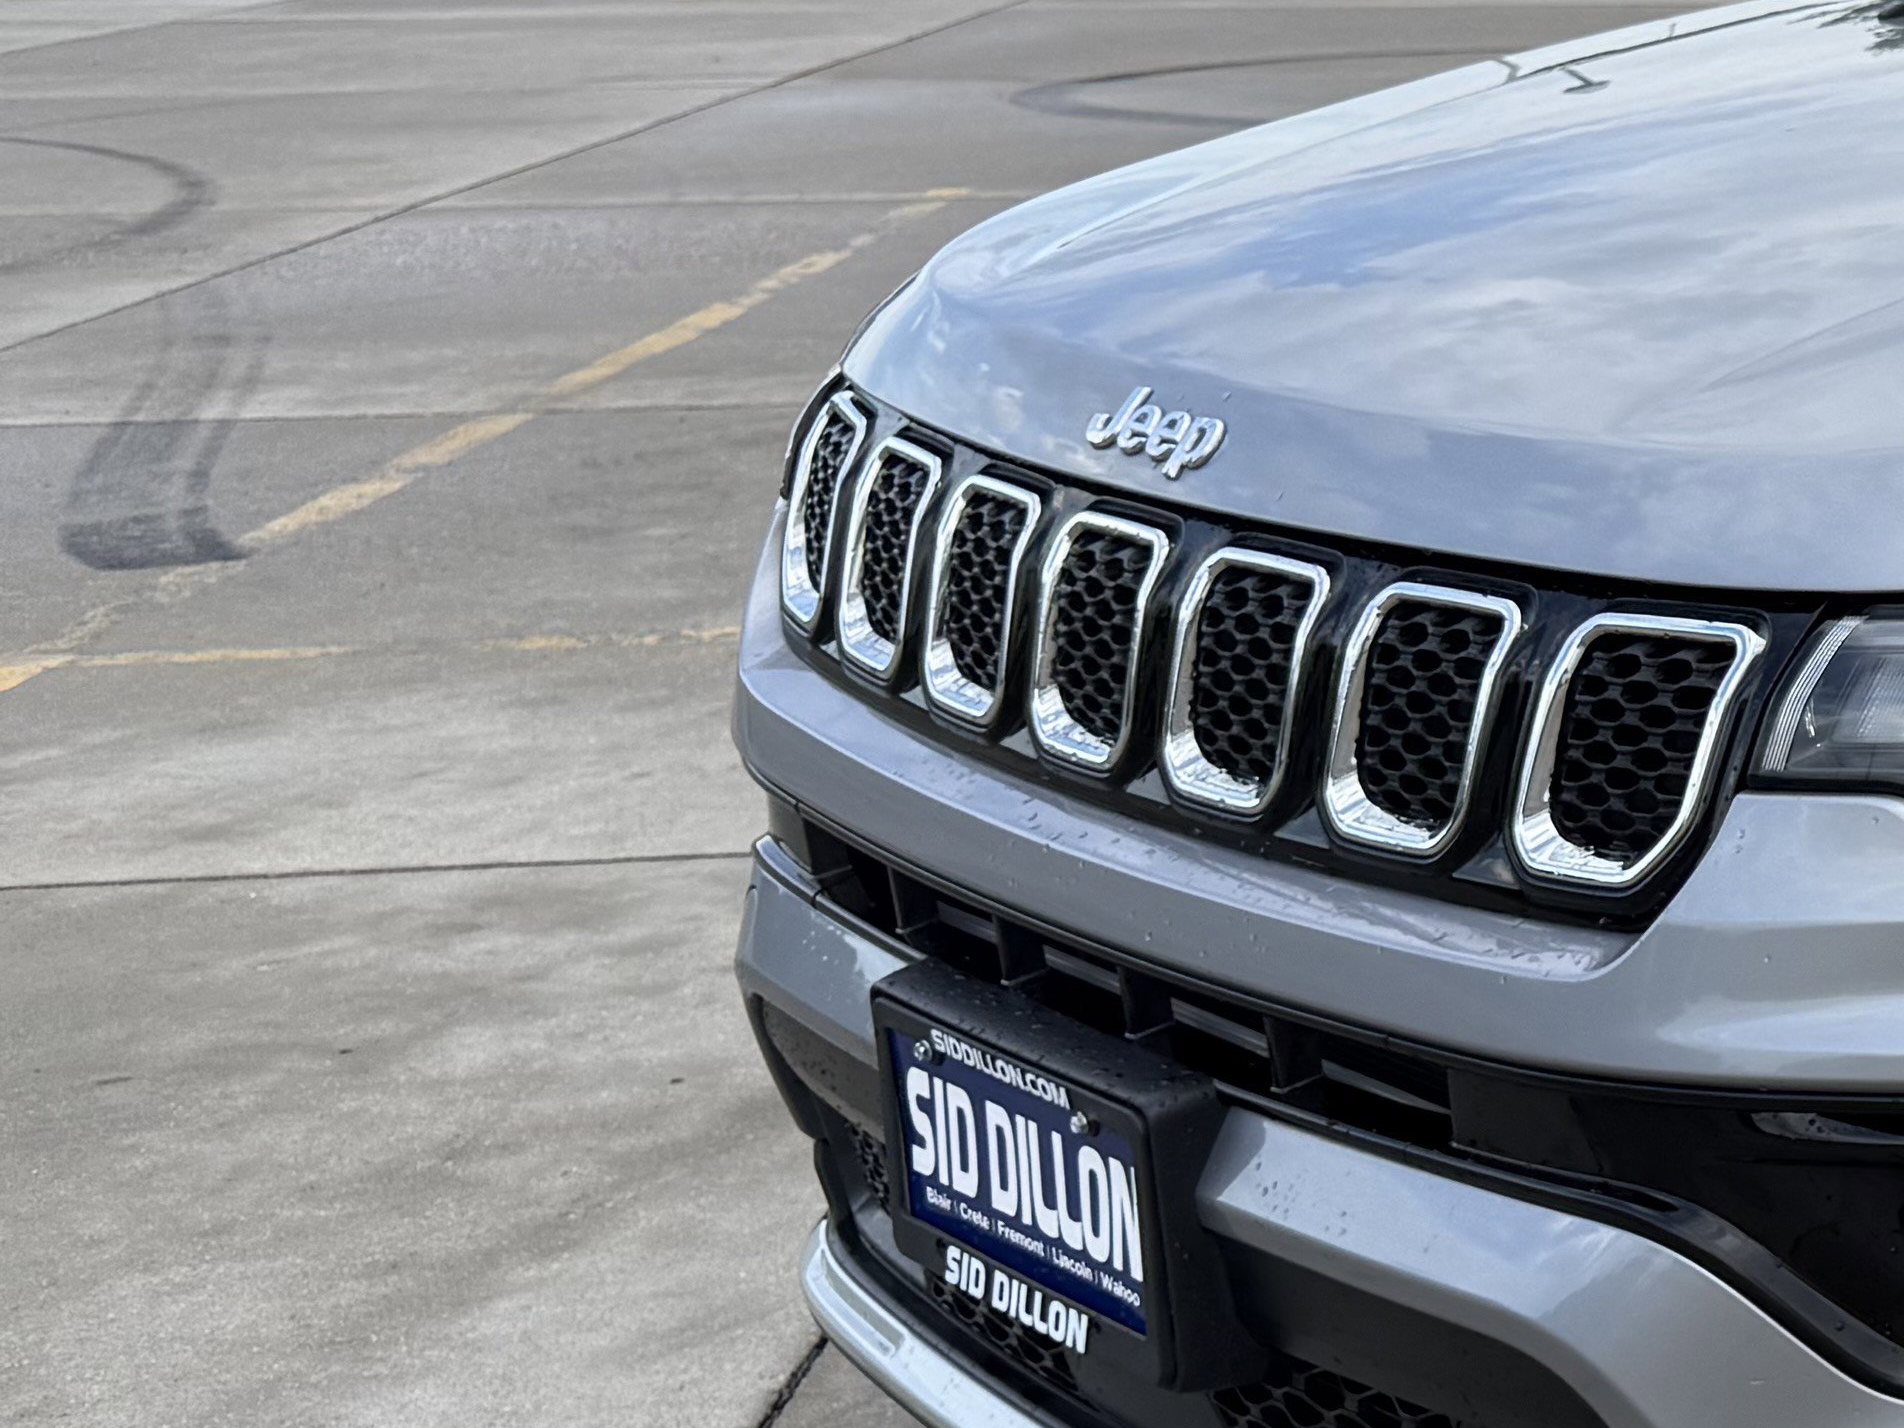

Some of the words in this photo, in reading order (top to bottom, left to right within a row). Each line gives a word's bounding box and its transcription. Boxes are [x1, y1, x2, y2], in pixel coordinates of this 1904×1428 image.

[1085, 386, 1227, 480] Jeep
[930, 1029, 1071, 1110] SIDDILLON.COM
[906, 1066, 978, 1199] SID
[985, 1100, 1144, 1282] DILLON
[926, 1186, 952, 1211] Blair
[960, 1202, 990, 1231] Crete
[997, 1220, 1045, 1257] Fremont
[1052, 1246, 1094, 1282] Lincoln
[1100, 1272, 1141, 1307] Wahoo
[945, 1245, 986, 1300] SID
[991, 1269, 1088, 1354] DILLON
